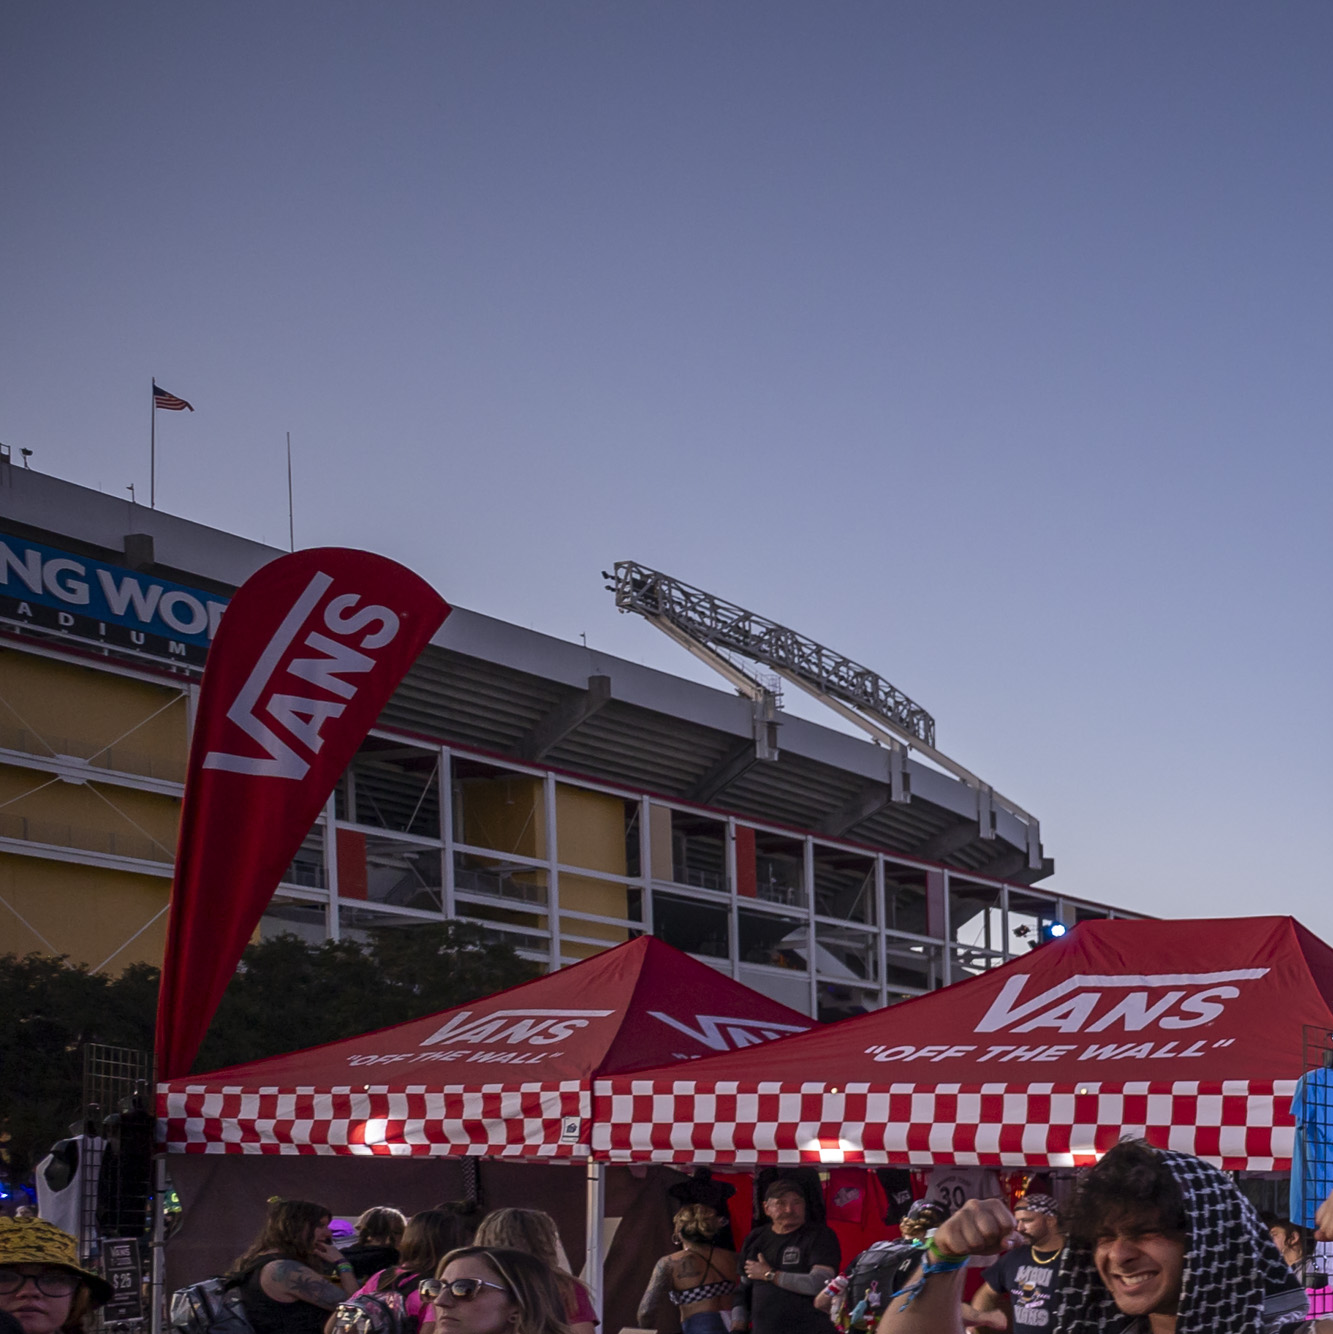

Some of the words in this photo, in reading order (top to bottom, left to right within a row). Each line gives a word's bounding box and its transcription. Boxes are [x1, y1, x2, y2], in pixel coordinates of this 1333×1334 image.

[203, 572, 400, 781] VANS
[973, 967, 1271, 1033] VANS
[420, 1009, 616, 1046] VANS
[408, 1051, 471, 1063] THE
[976, 1044, 1077, 1062] THE
[1014, 1305, 1049, 1326] VANS
